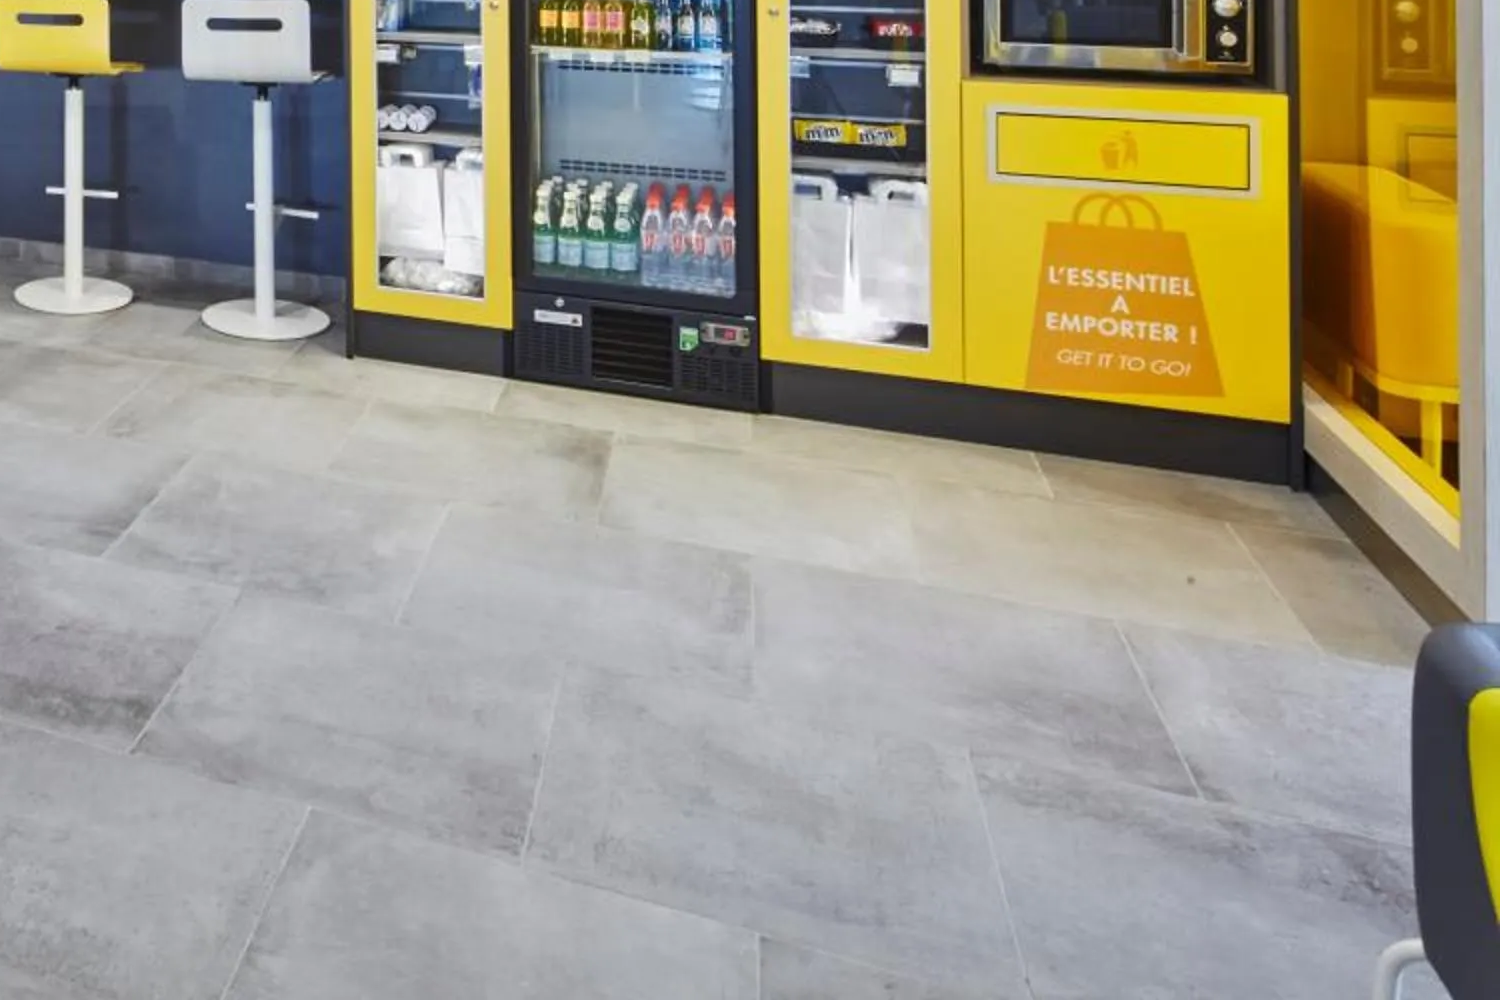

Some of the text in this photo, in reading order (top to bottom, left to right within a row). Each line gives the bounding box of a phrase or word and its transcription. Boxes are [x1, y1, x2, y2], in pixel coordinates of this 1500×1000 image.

[1047, 265, 1196, 298] L'ESSENTIEL
[1110, 294, 1130, 314] A
[1045, 312, 1179, 343] EMPORTER
[1055, 349, 1193, 377] GET IT TO GO!
